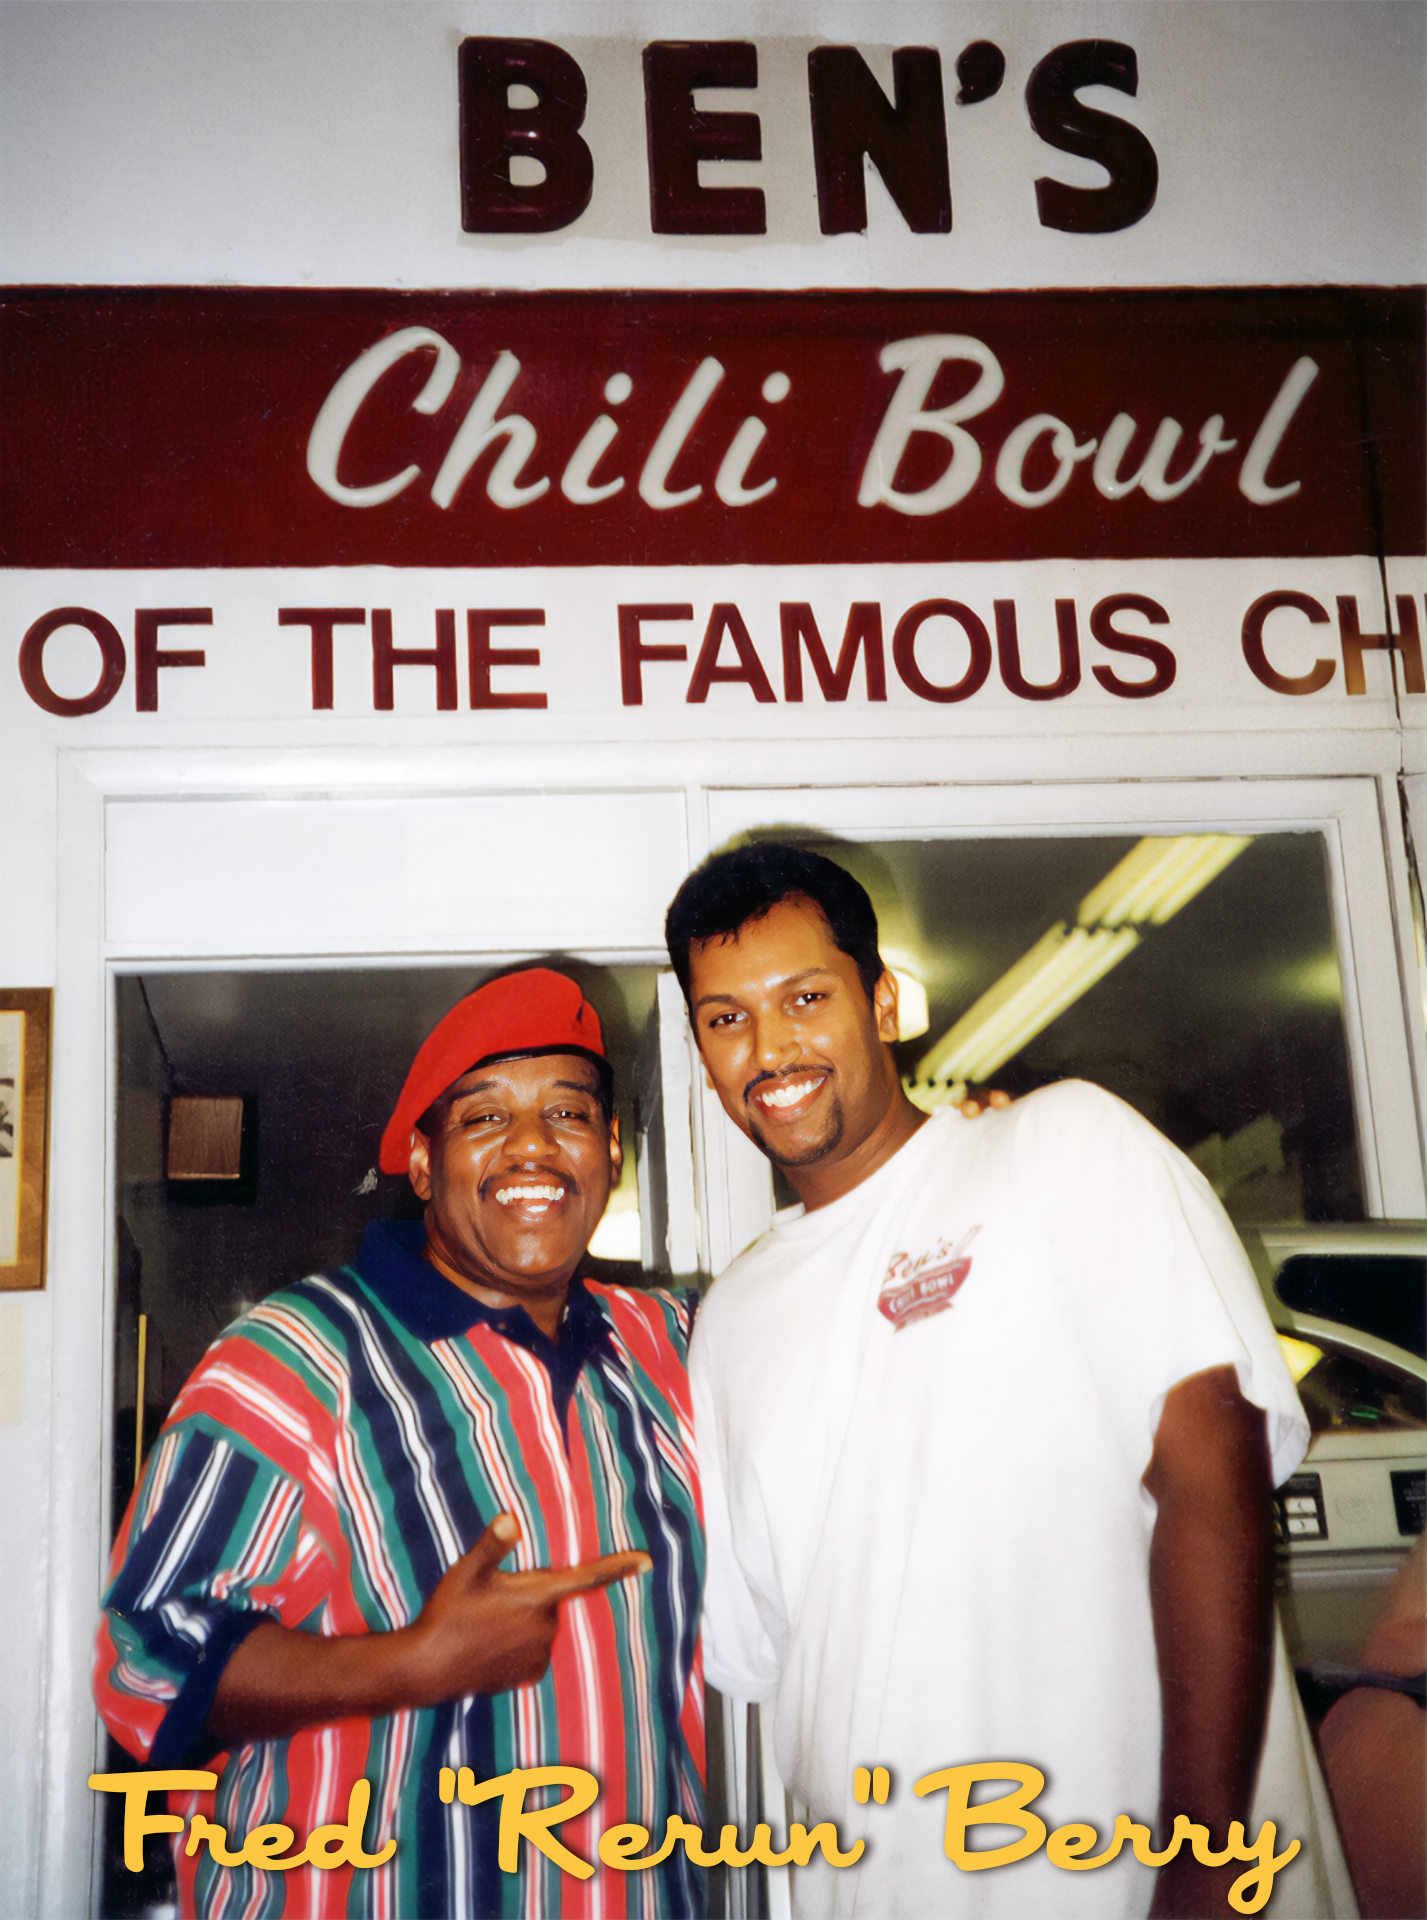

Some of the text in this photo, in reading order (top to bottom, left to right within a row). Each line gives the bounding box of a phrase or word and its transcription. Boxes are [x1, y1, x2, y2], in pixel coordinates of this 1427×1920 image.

[458, 37, 1159, 234] BEN'S
[306, 327, 1318, 516] Chili Bowl
[18, 589, 1427, 717] OF THE FAMOUS CH
